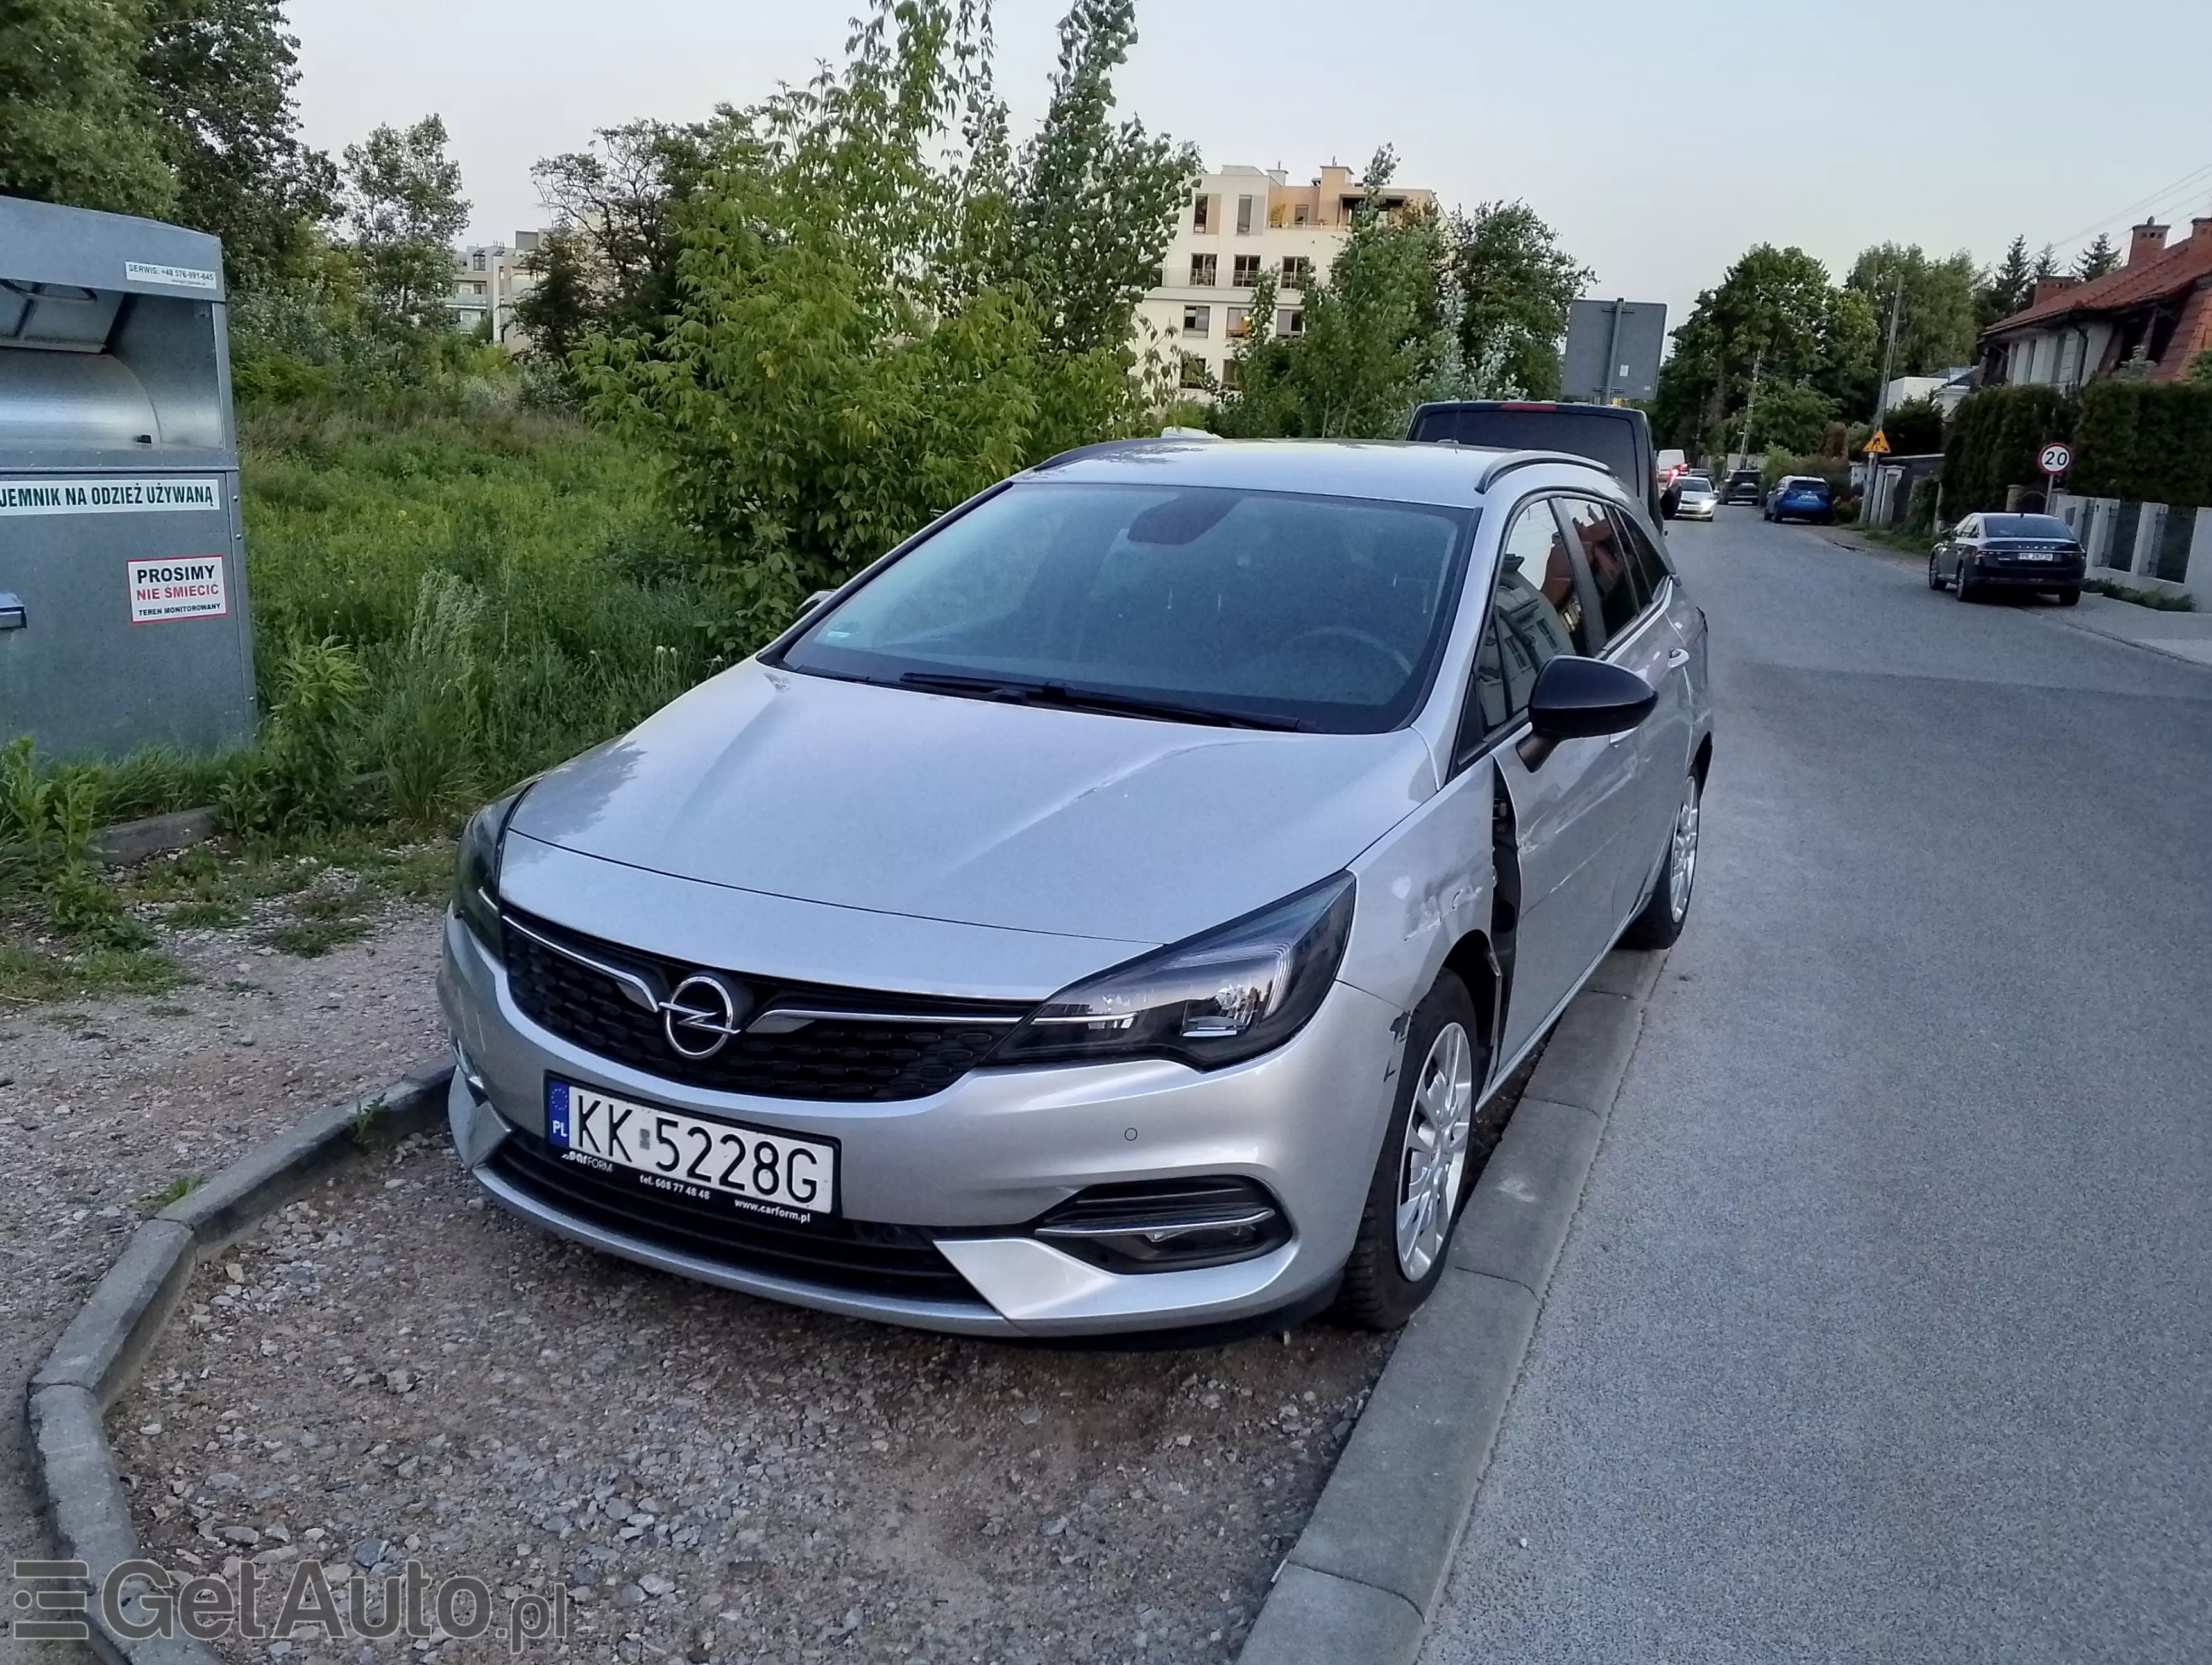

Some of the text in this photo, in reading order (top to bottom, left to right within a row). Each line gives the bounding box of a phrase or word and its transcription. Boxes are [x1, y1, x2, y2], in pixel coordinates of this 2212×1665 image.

[128, 264, 160, 275] SERWIS:
[2045, 451, 2067, 466] 20
[0, 482, 214, 507] JEMNIK NA ODZIEŻ UŻYWANĄ
[137, 564, 215, 584] PROSIMY
[137, 582, 219, 600] NIE ŚMIECIĆ
[164, 603, 221, 614] MONITOROWANY
[552, 1120, 568, 1137] PL
[578, 1095, 818, 1203] KK 5228G
[640, 1174, 710, 1200] tel. 608 77 48 48
[735, 1199, 810, 1223] www.carform.pl
